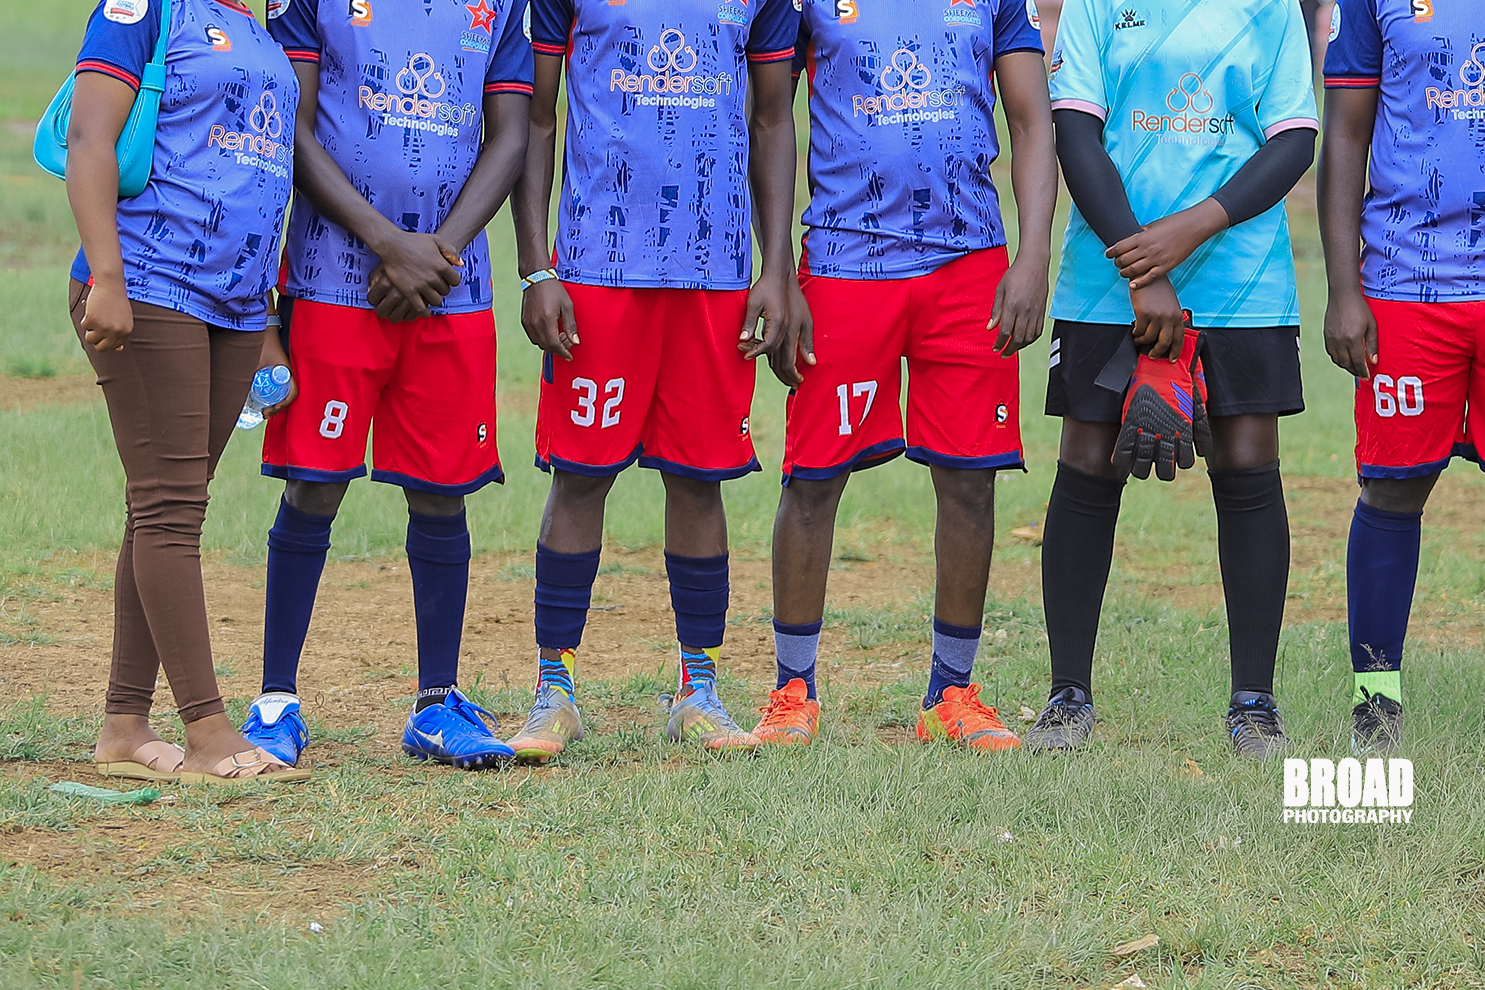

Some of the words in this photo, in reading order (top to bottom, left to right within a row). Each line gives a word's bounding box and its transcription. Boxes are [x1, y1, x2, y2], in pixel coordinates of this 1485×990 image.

[351, 0, 368, 18] S
[838, 0, 854, 17] S
[943, 9, 979, 19] SHEEMA
[1114, 19, 1146, 31] KELME
[610, 69, 733, 96] Rendersoft
[358, 85, 477, 127] Rendersoft
[635, 93, 716, 109] Technologies
[382, 113, 459, 137] Technologies
[875, 108, 955, 126] Technologies
[208, 124, 294, 165] Renders
[570, 376, 625, 429] 32
[836, 379, 878, 436] 17
[1373, 373, 1425, 417] 60
[319, 399, 349, 439] 8
